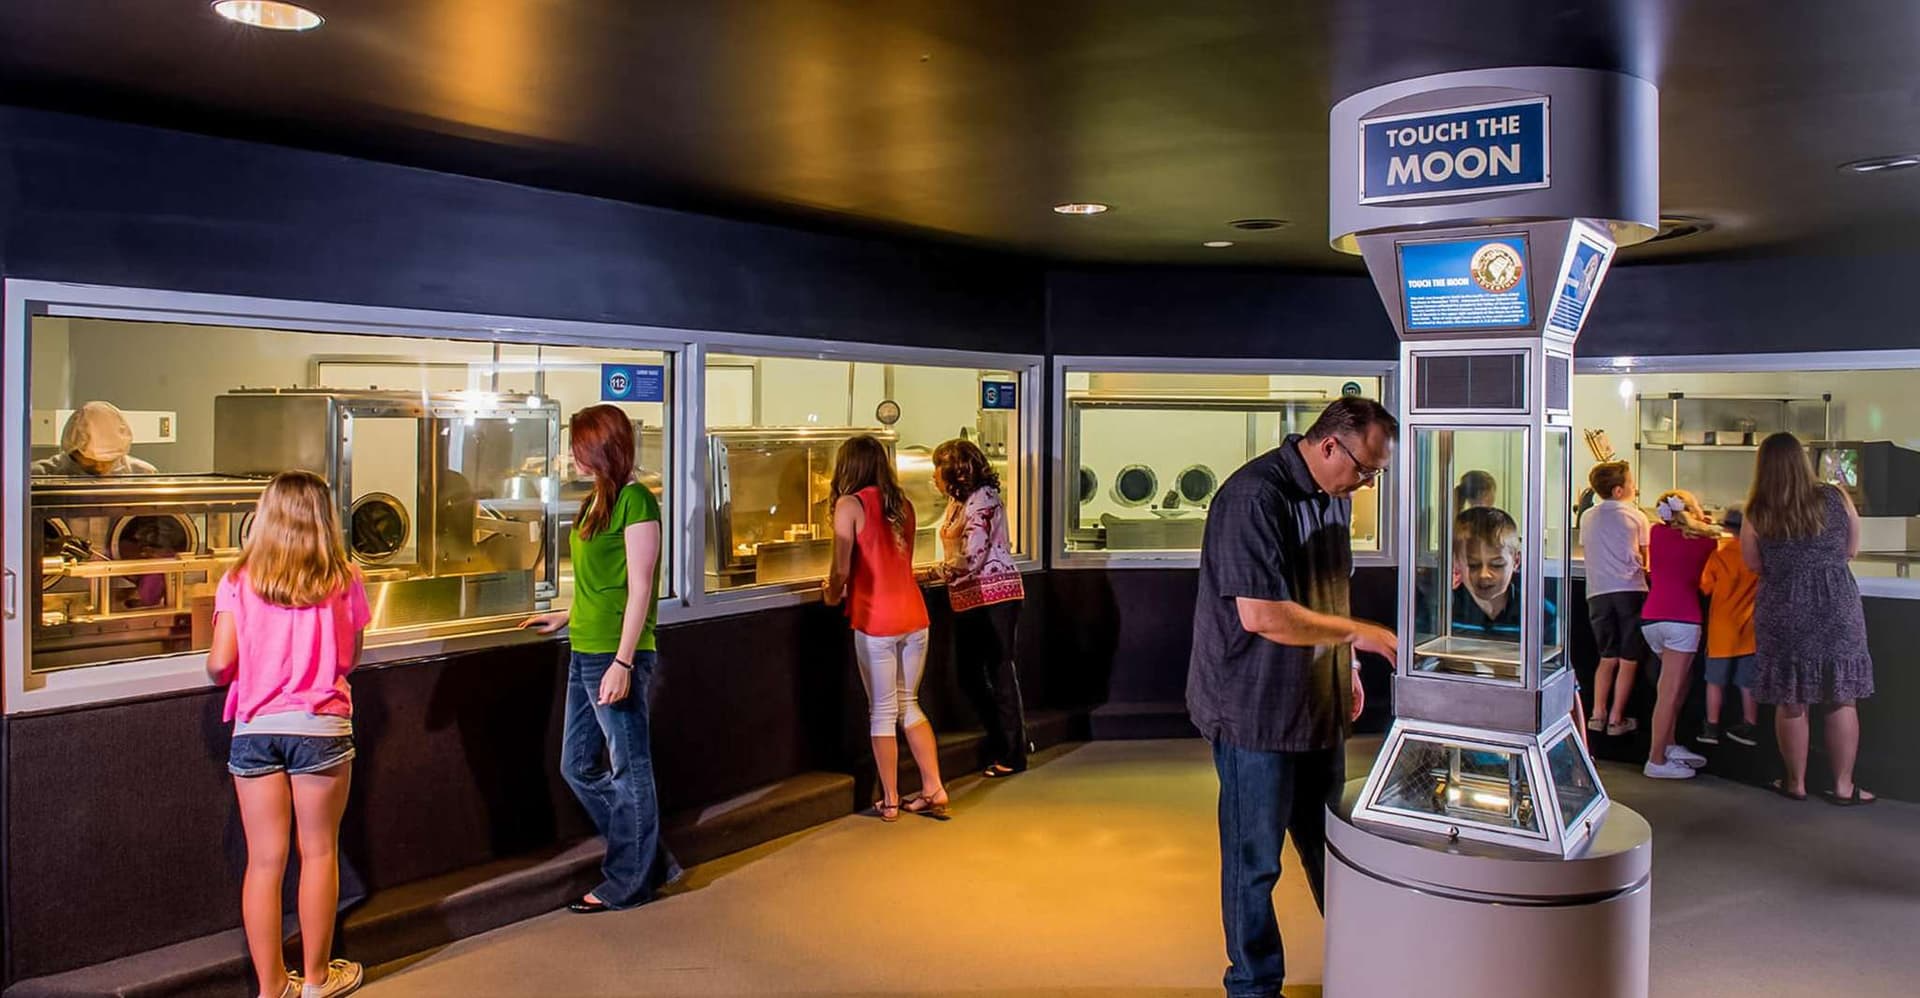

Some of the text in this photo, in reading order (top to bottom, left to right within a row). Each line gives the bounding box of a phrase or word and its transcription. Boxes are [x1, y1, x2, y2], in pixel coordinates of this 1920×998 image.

[1386, 115, 1520, 147] TOUCH THE
[1386, 143, 1521, 186] MOON
[611, 379, 625, 388] 112
